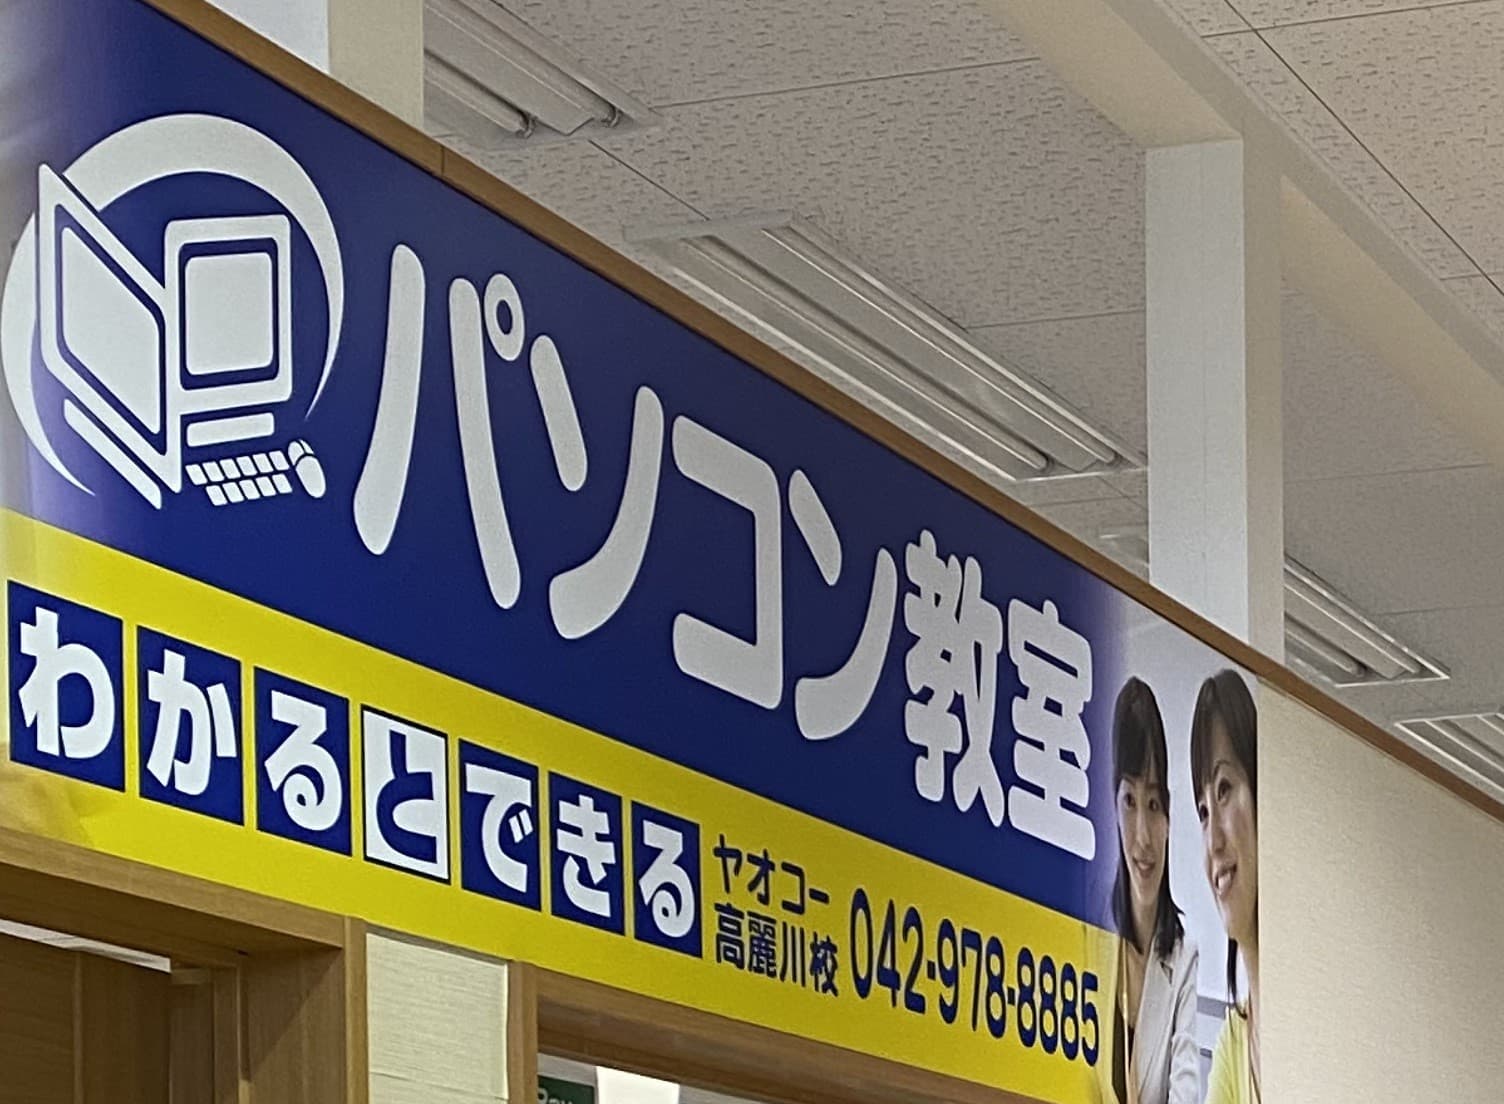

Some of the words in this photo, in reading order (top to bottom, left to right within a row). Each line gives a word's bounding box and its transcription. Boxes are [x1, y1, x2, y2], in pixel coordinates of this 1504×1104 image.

[352, 243, 1097, 861] パソコン教室
[17, 604, 697, 940] わかるとできる
[713, 842, 830, 914] ヤオコー
[715, 902, 839, 997] 高麗川校
[850, 888, 1100, 1068] 042-978-8885
